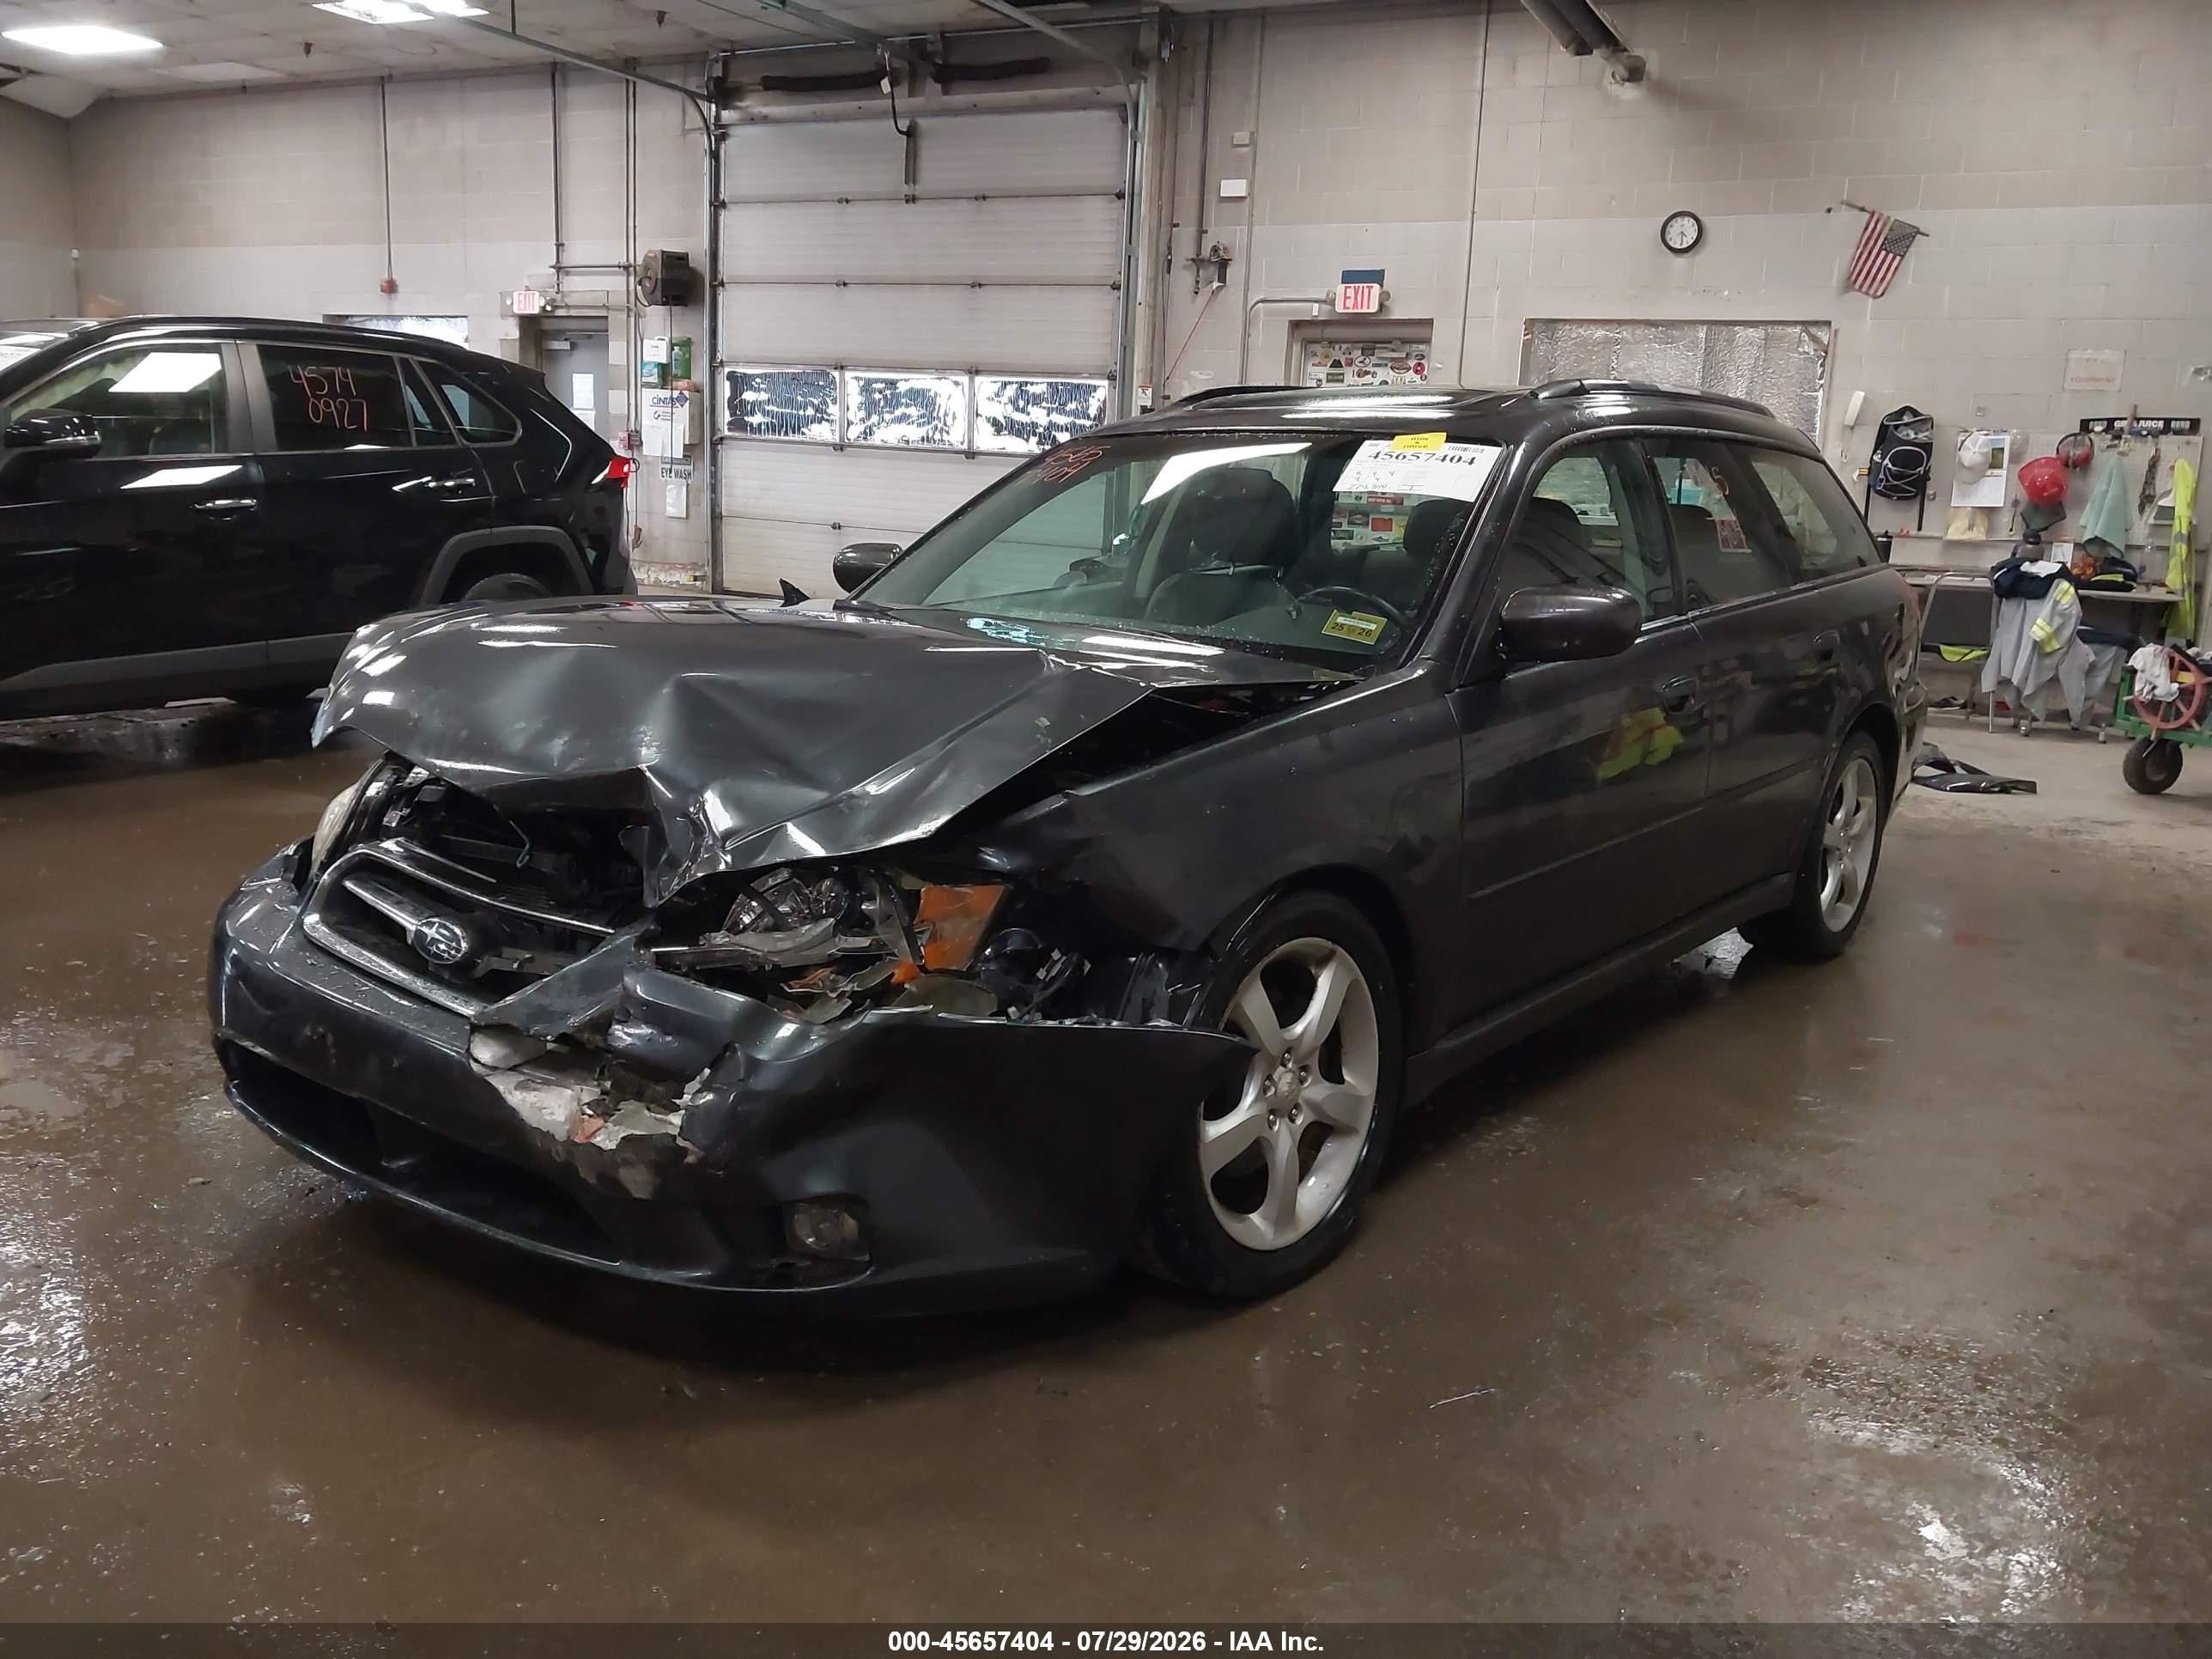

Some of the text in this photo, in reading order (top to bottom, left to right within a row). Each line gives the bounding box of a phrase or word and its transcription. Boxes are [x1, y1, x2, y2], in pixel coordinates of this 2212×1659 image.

[518, 292, 537, 312] EXIT
[1342, 285, 1374, 310] EXIT
[289, 365, 356, 397] 4574
[309, 397, 368, 432] 0927
[1367, 451, 1476, 465] 45657404
[660, 467, 692, 480] EYE WASH
[1331, 622, 1345, 631] 25
[1358, 628, 1372, 637] 26
